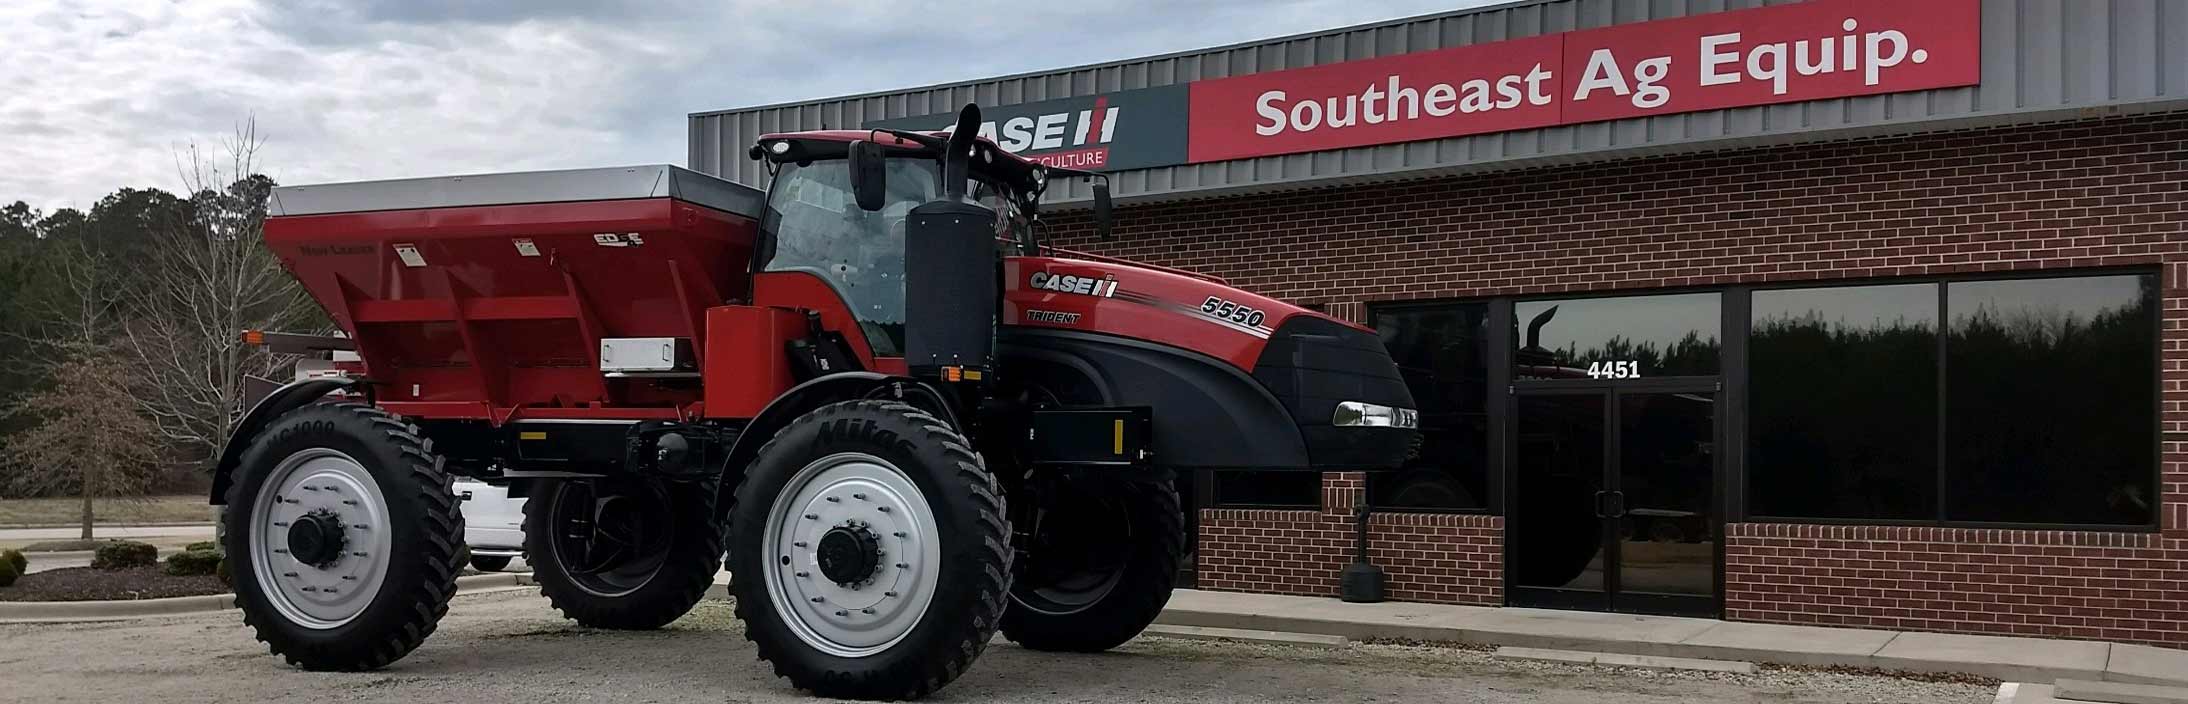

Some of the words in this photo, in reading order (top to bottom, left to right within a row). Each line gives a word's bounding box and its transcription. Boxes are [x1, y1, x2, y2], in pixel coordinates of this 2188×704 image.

[1255, 62, 1553, 136] Southeast
[1573, 48, 1672, 108] Ag
[1700, 18, 1929, 96] Equip.
[943, 112, 1069, 153] ASE
[1038, 151, 1103, 168] CULTURE
[1030, 272, 1093, 294] CASE
[1026, 310, 1081, 324] TRIDENT
[1200, 296, 1266, 328] 5550
[1587, 360, 1641, 379] 4451
